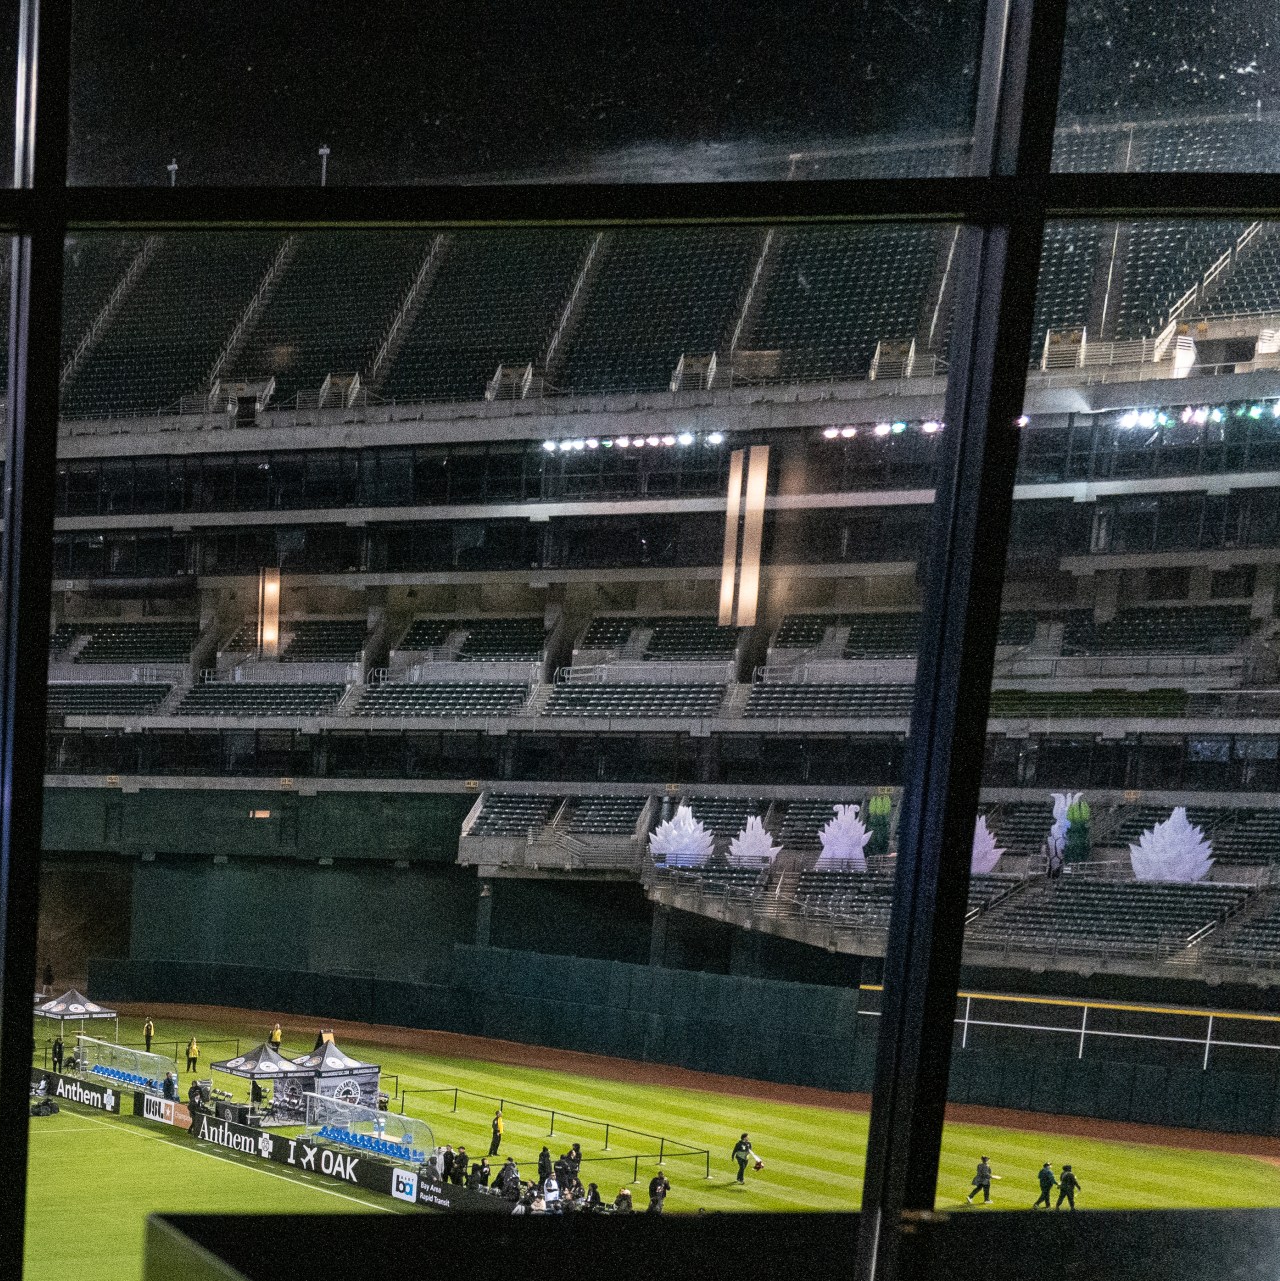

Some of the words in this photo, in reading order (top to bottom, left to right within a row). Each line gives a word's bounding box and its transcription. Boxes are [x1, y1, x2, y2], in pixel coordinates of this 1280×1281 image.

[56, 1078, 102, 1109] Anthem
[197, 1115, 255, 1155] Anthem
[287, 1140, 297, 1164] I
[321, 1150, 359, 1182] OAK
[419, 1191, 433, 1203] Rapid
[433, 1195, 450, 1208] Transit
[420, 1181, 430, 1192] Bay
[430, 1184, 442, 1194] Area
